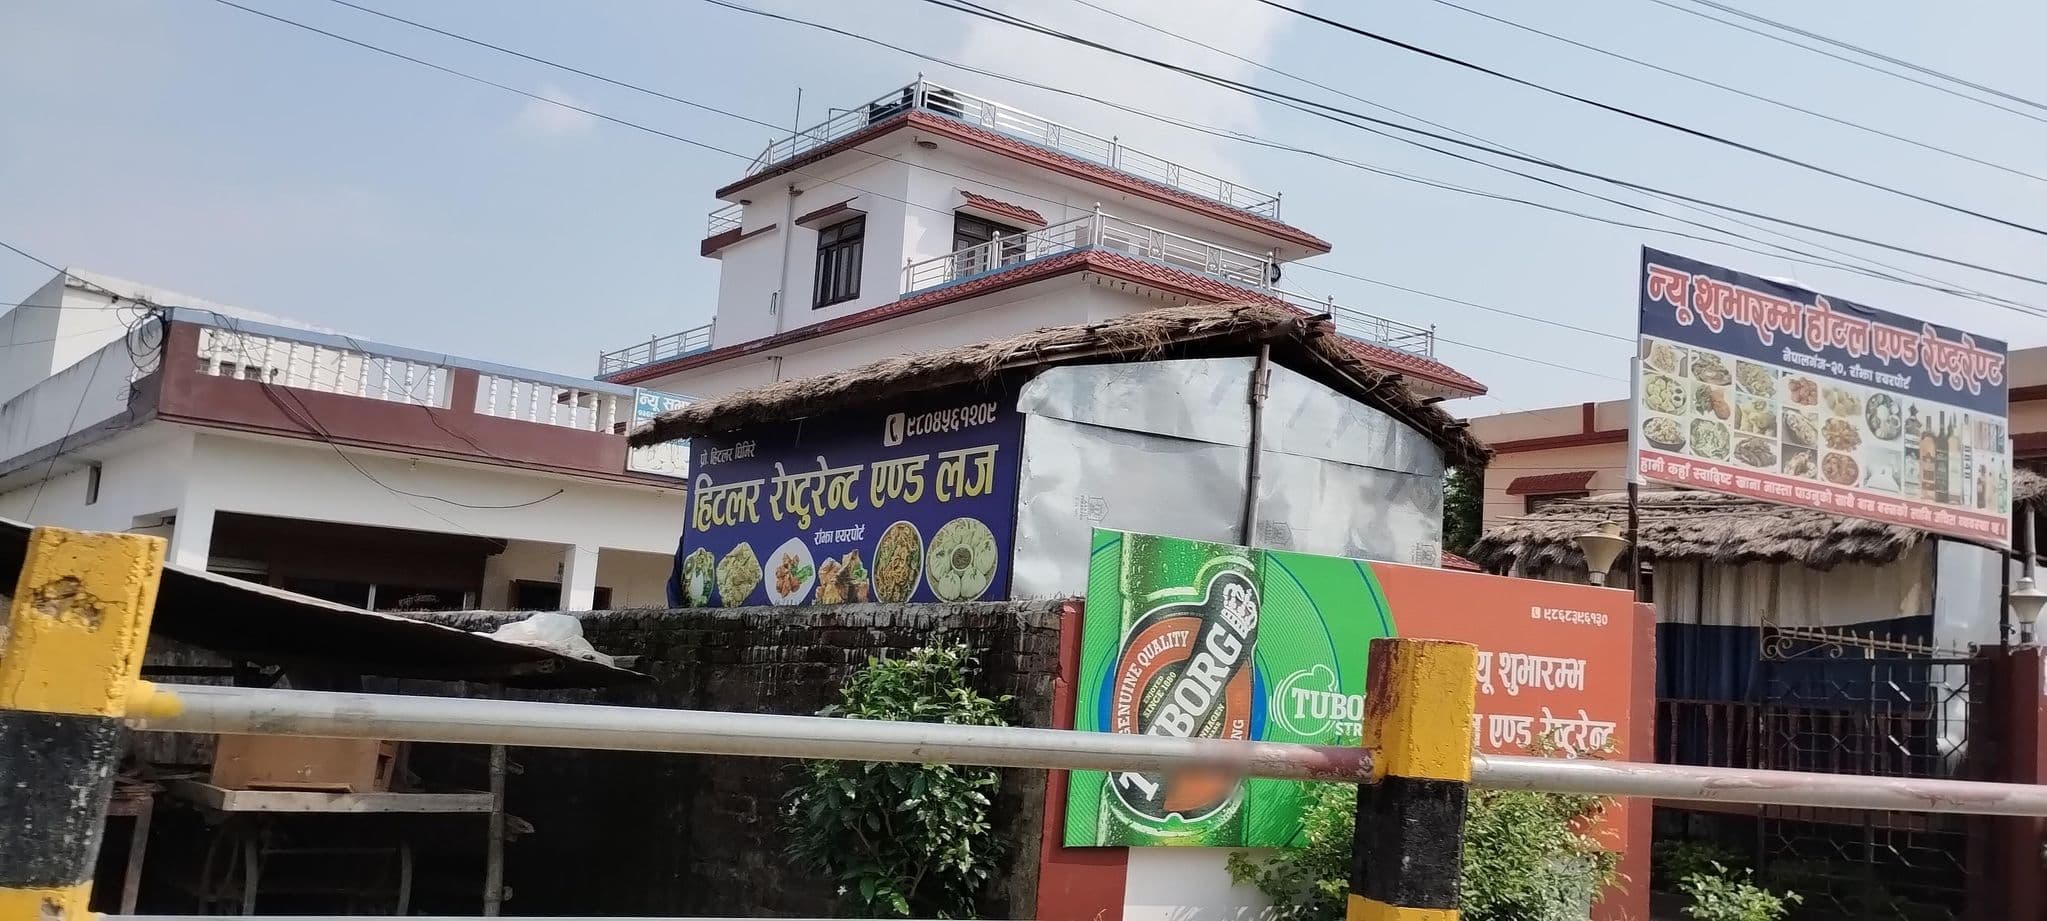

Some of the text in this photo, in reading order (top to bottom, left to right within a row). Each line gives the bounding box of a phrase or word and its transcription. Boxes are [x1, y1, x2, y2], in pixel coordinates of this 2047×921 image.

[1647, 263, 1693, 325] न्यू
[1693, 275, 1803, 346] शुभारम्भ
[1804, 294, 1871, 358] होटल
[1872, 320, 1921, 366] एण्ड
[906, 401, 998, 437] ९८०४५६१२०९
[710, 447, 734, 465] हिटलर
[692, 472, 766, 533] हिटलर
[869, 453, 930, 508] एण्ड
[935, 445, 999, 502] लज
[835, 523, 866, 543] एयरपोर्ट
[1137, 630, 1190, 667] QUALITY
[1475, 651, 1587, 696] यू शुभारम्भ
[1118, 622, 1243, 802] TBORG
[1142, 671, 1177, 718] SINCE 1880
[1291, 687, 1366, 721] TUBO
[1488, 713, 1535, 748] एण्ड
